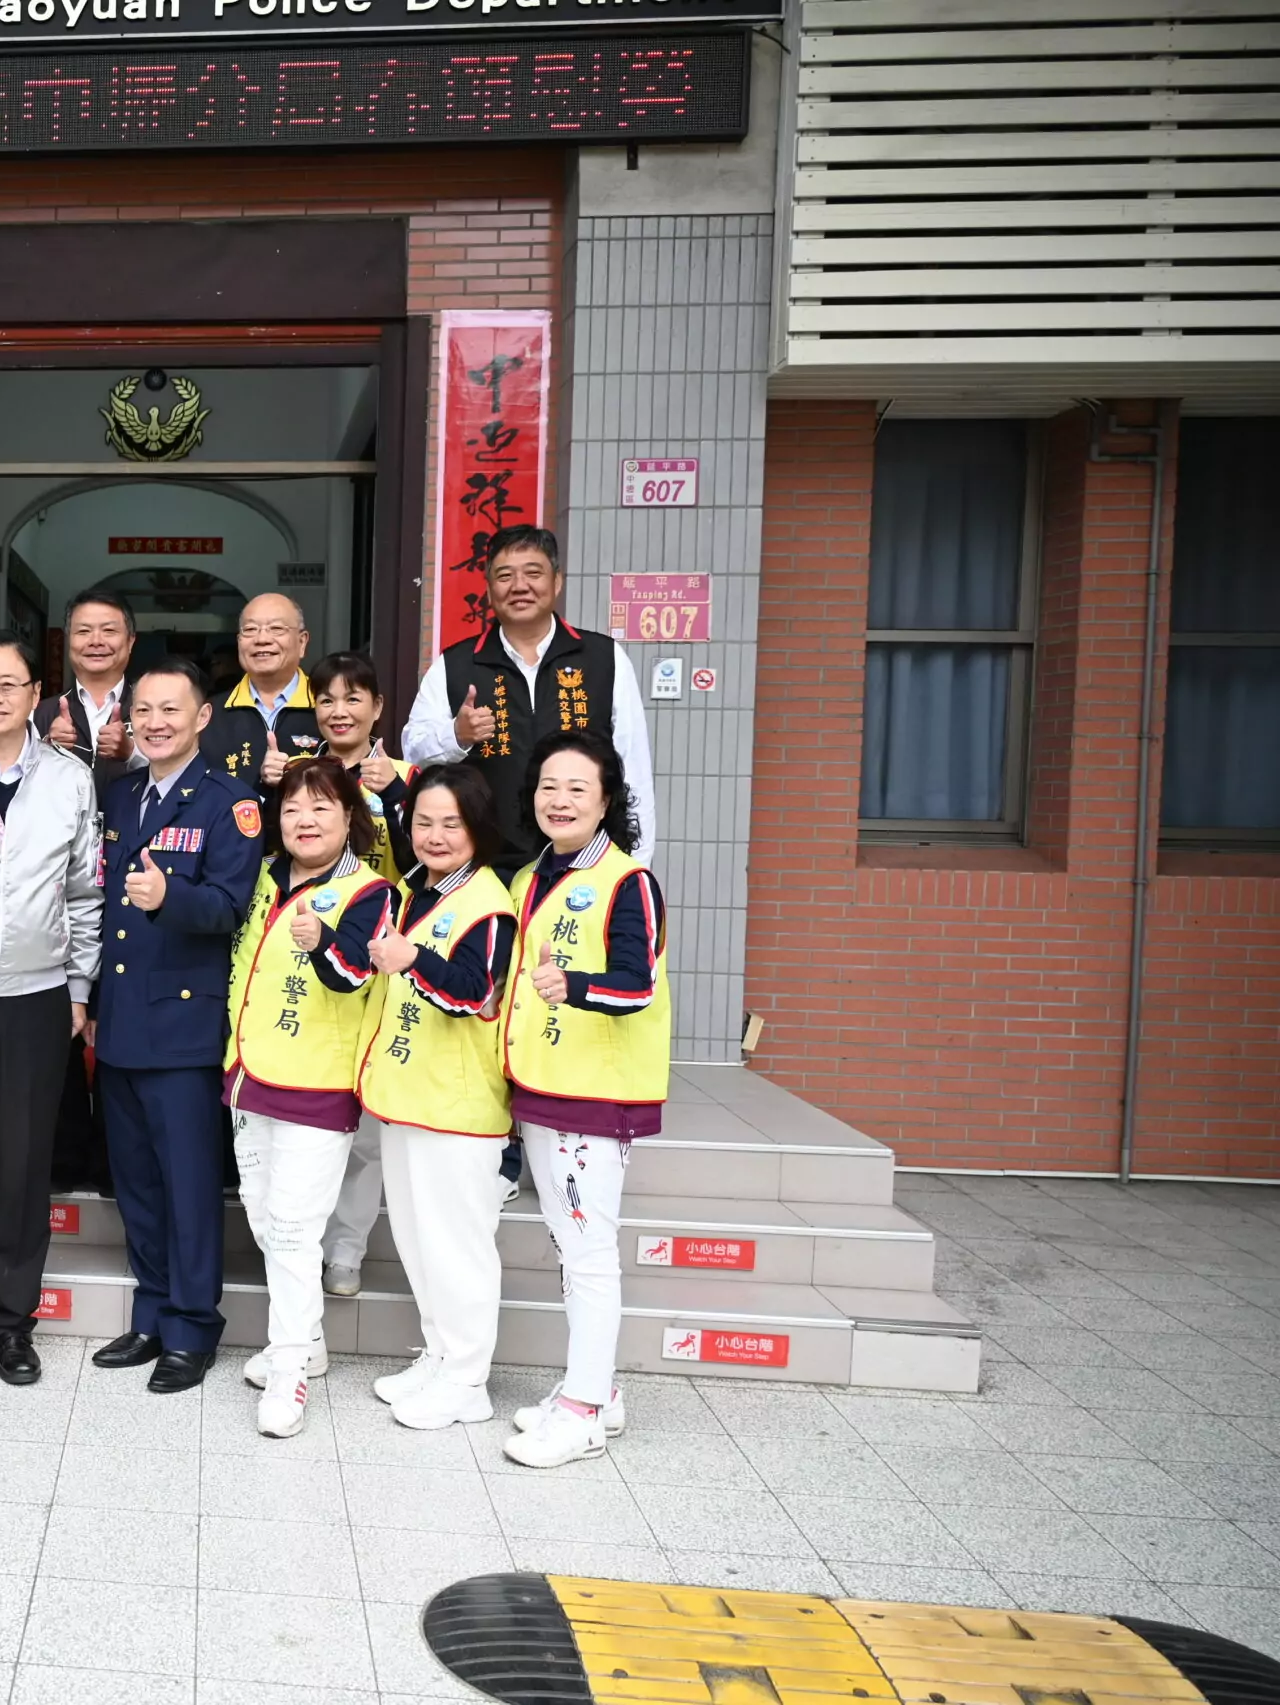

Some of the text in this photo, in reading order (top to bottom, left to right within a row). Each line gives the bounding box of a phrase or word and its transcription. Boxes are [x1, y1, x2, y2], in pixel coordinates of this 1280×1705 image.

[646, 462, 687, 471] 延平路
[642, 479, 686, 502] 607
[622, 576, 701, 589] 延平路
[671, 590, 687, 599] Rd.
[639, 606, 699, 638] 607
[493, 675, 512, 757] 中壢中隊中隊長
[571, 688, 590, 729] 桃園市
[541, 914, 579, 1046] 桃市局
[273, 950, 310, 1037] 市警局
[686, 1243, 740, 1257] 小心台階
[716, 1336, 773, 1351] 小心台階
